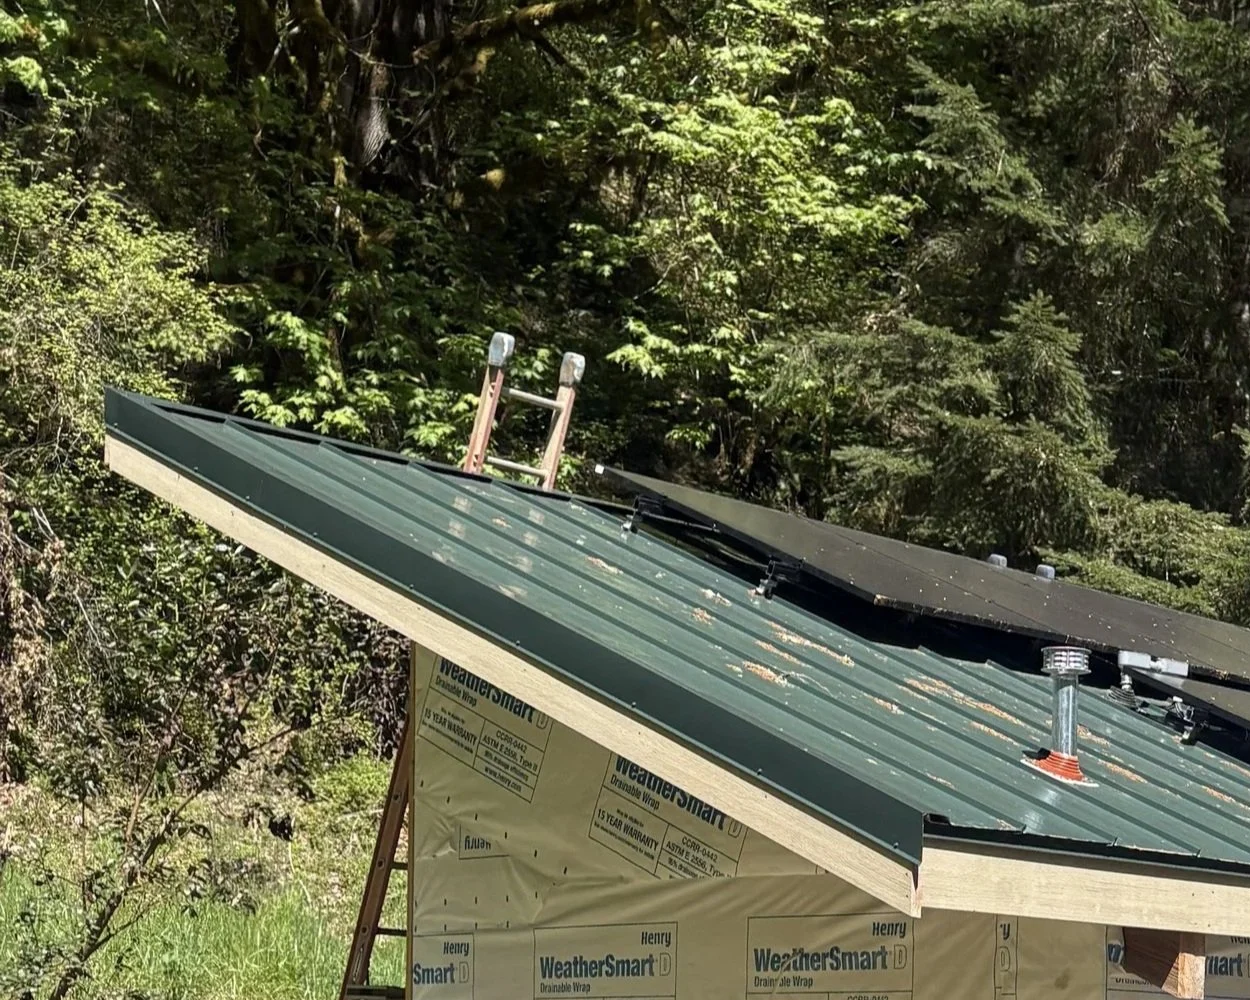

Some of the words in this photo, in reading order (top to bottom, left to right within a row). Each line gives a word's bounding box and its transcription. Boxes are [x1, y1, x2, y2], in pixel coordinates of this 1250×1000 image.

[641, 793, 660, 811] Wrap
[606, 813, 623, 829] YEAR
[623, 822, 659, 851] WARRANTY
[872, 922, 907, 938] Henry
[641, 931, 671, 947] Henry
[443, 942, 470, 957] Henry
[540, 954, 655, 979] WeatherSmart
[754, 945, 888, 972] WeatherSmart
[540, 982, 571, 993] Drainable
[572, 982, 591, 995] Wrap
[792, 976, 814, 988] Wrap
